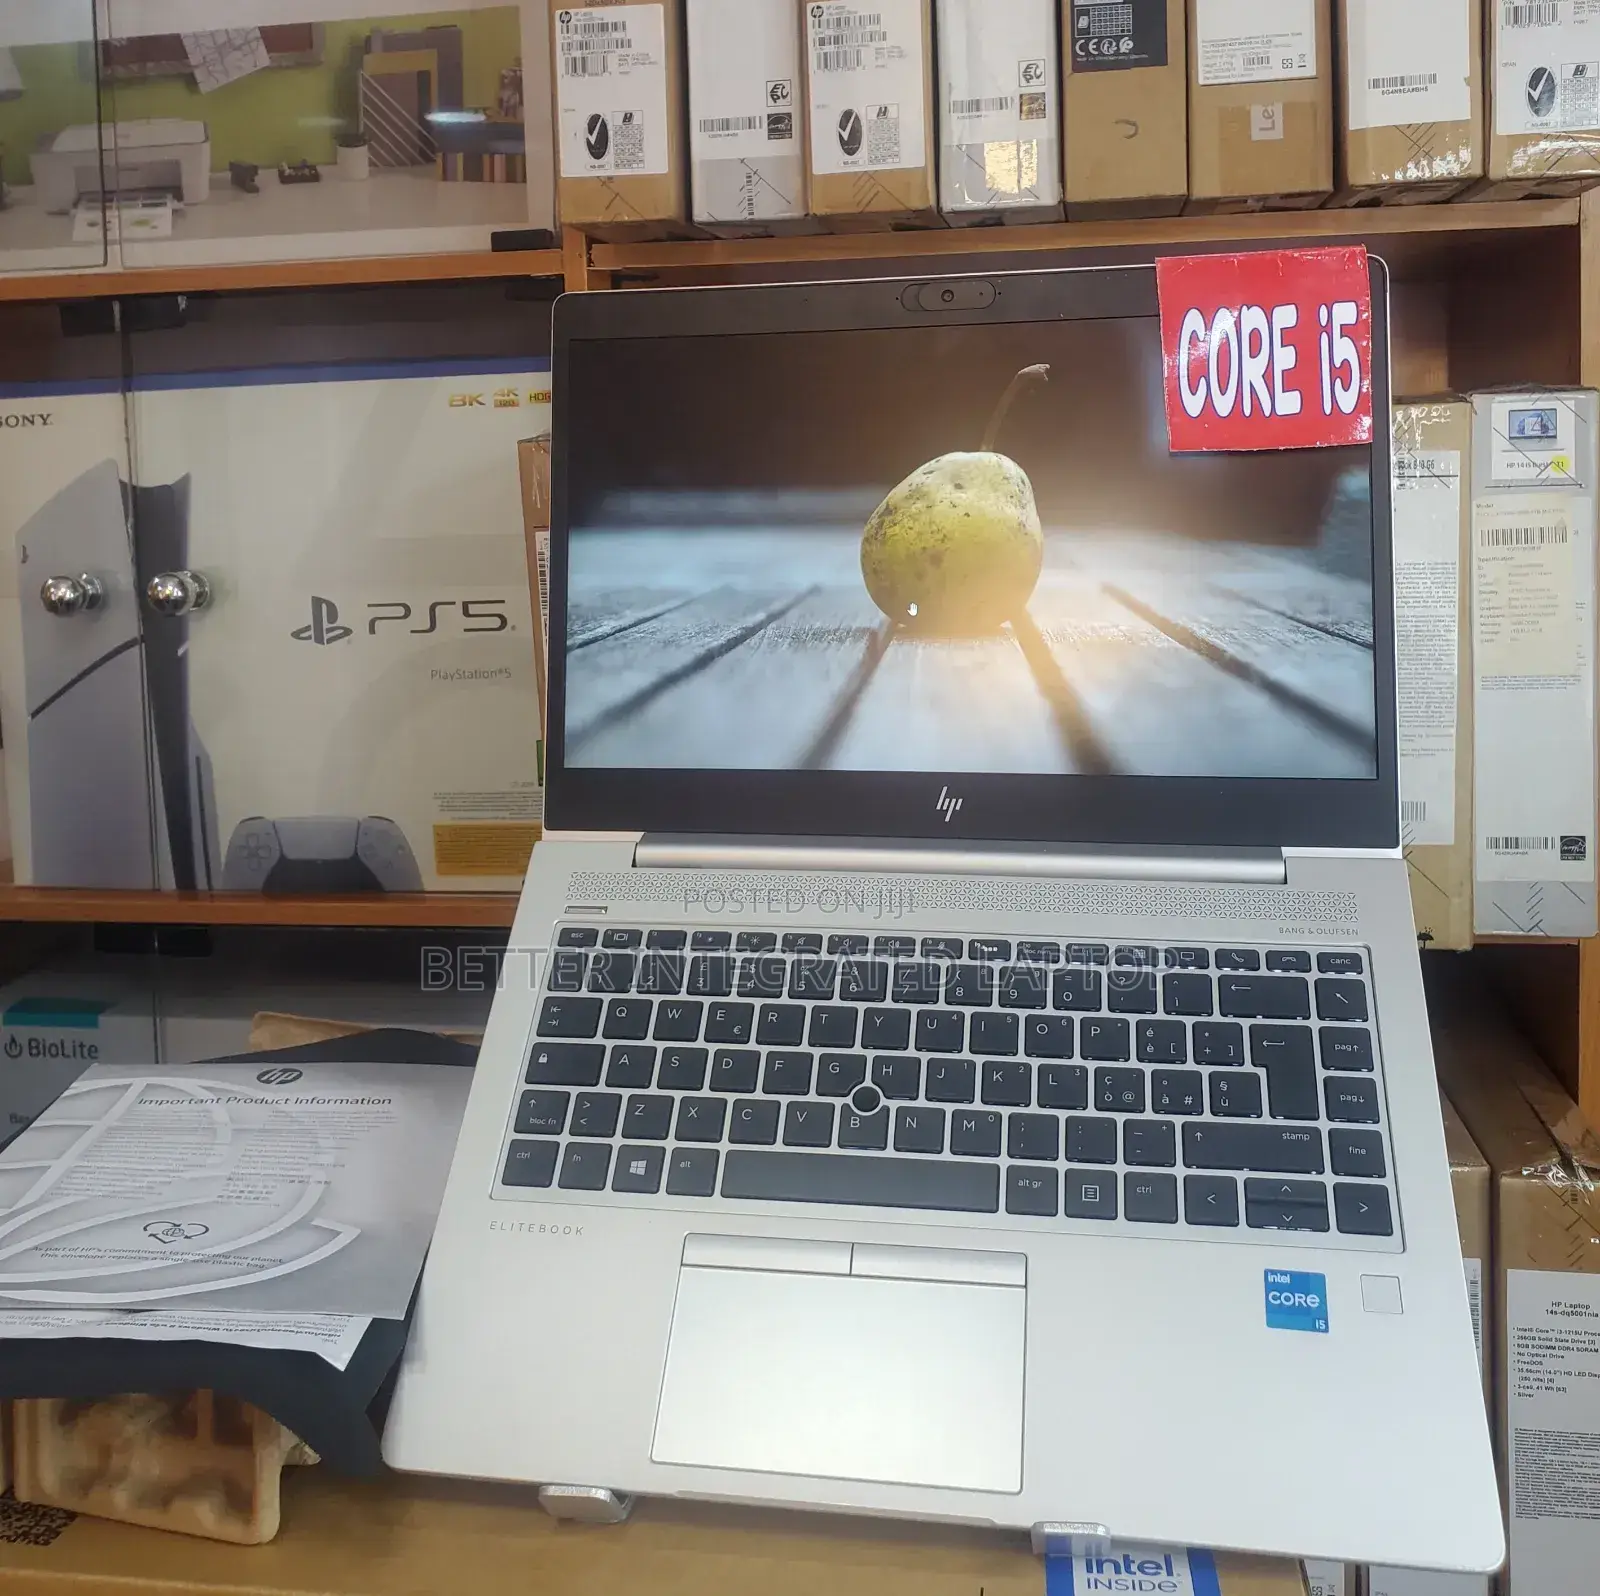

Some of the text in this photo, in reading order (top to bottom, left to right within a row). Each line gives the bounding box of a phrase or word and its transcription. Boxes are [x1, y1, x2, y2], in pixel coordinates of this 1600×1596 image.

[1075, 38, 1099, 56] CE
[1177, 300, 1362, 419] CORE i5
[448, 393, 486, 407] 8K
[367, 599, 508, 635] PS5
[935, 785, 964, 822] hp
[570, 931, 585, 939] esc
[1278, 926, 1359, 937] BANG & OLUFSEN
[1330, 957, 1352, 965] canc
[696, 977, 705, 987] 3
[746, 979, 756, 989] 4
[849, 983, 858, 993] 6
[955, 987, 964, 997] 8
[1009, 989, 1018, 999] 9
[616, 1006, 628, 1018] Q
[667, 1008, 682, 1019] W
[716, 1009, 726, 1021] E
[768, 1012, 778, 1023] R
[820, 1014, 829, 1025] T
[874, 1016, 884, 1027] Y
[926, 1018, 937, 1030] U
[1036, 1023, 1048, 1035] O
[1090, 1026, 1101, 1037] P
[28, 1037, 99, 1060] BioLite
[1335, 1043, 1352, 1052] pag
[618, 1054, 630, 1066] A
[670, 1056, 680, 1067] S
[722, 1058, 733, 1069] D
[774, 1060, 784, 1072] F
[829, 1062, 840, 1074] G
[882, 1064, 893, 1076] H
[257, 1068, 303, 1085] hp
[936, 1067, 945, 1079] J
[993, 1070, 1004, 1082] K
[1049, 1074, 1058, 1085] L
[138, 1096, 392, 1107] Important Product Information
[1122, 1090, 1136, 1103] @
[1340, 1094, 1358, 1103] pag
[634, 1104, 646, 1116] Z
[687, 1106, 699, 1118] X
[741, 1109, 752, 1121] C
[529, 1116, 557, 1126] bloc fn
[796, 1111, 808, 1123] V
[850, 1117, 861, 1128] B
[906, 1117, 917, 1128] N
[963, 1120, 976, 1132] M
[1282, 1131, 1310, 1142] stamp
[516, 1151, 531, 1159] ctrl
[1349, 1146, 1367, 1155] fine
[572, 1153, 582, 1162] fn
[679, 1160, 691, 1169] alt
[1018, 1178, 1042, 1189] alt gr
[1136, 1185, 1152, 1194] ctrl
[489, 1220, 585, 1236] ELITEBOOK
[104, 1247, 167, 1255] commitment
[180, 1250, 231, 1260] protecting
[1267, 1271, 1291, 1284] intel
[1551, 1300, 1591, 1310] HP Laptop
